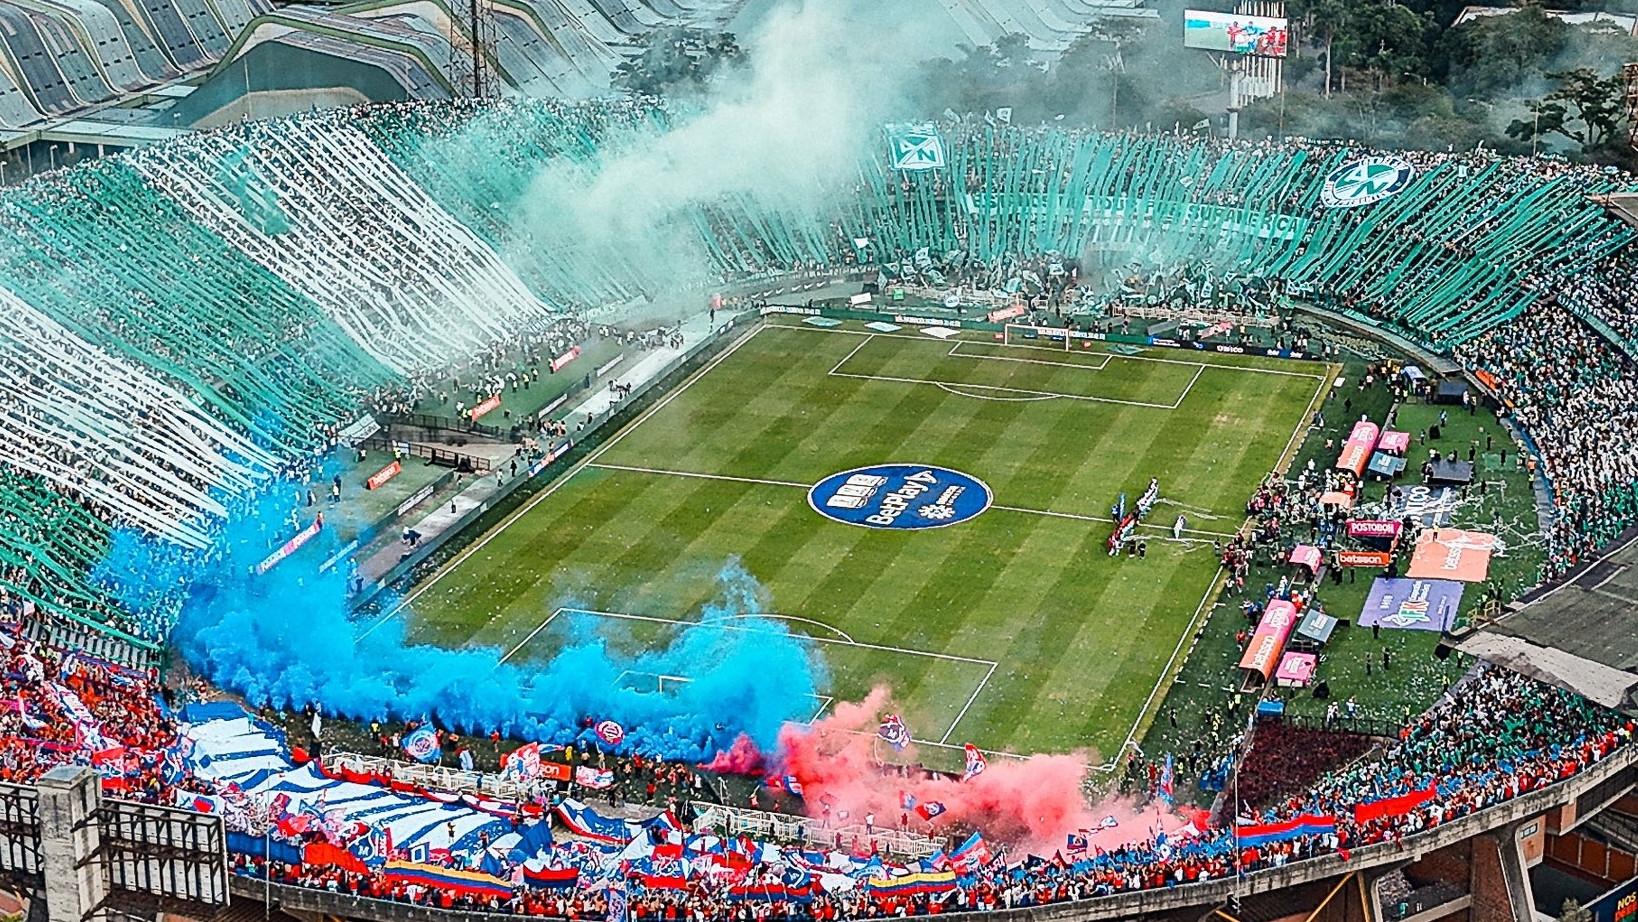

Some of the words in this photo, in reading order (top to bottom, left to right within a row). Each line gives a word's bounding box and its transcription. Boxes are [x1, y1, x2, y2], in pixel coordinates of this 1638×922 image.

[866, 481, 929, 526] BetPlay
[1340, 553, 1382, 564] betsson
[1616, 891, 1637, 911] NOS
